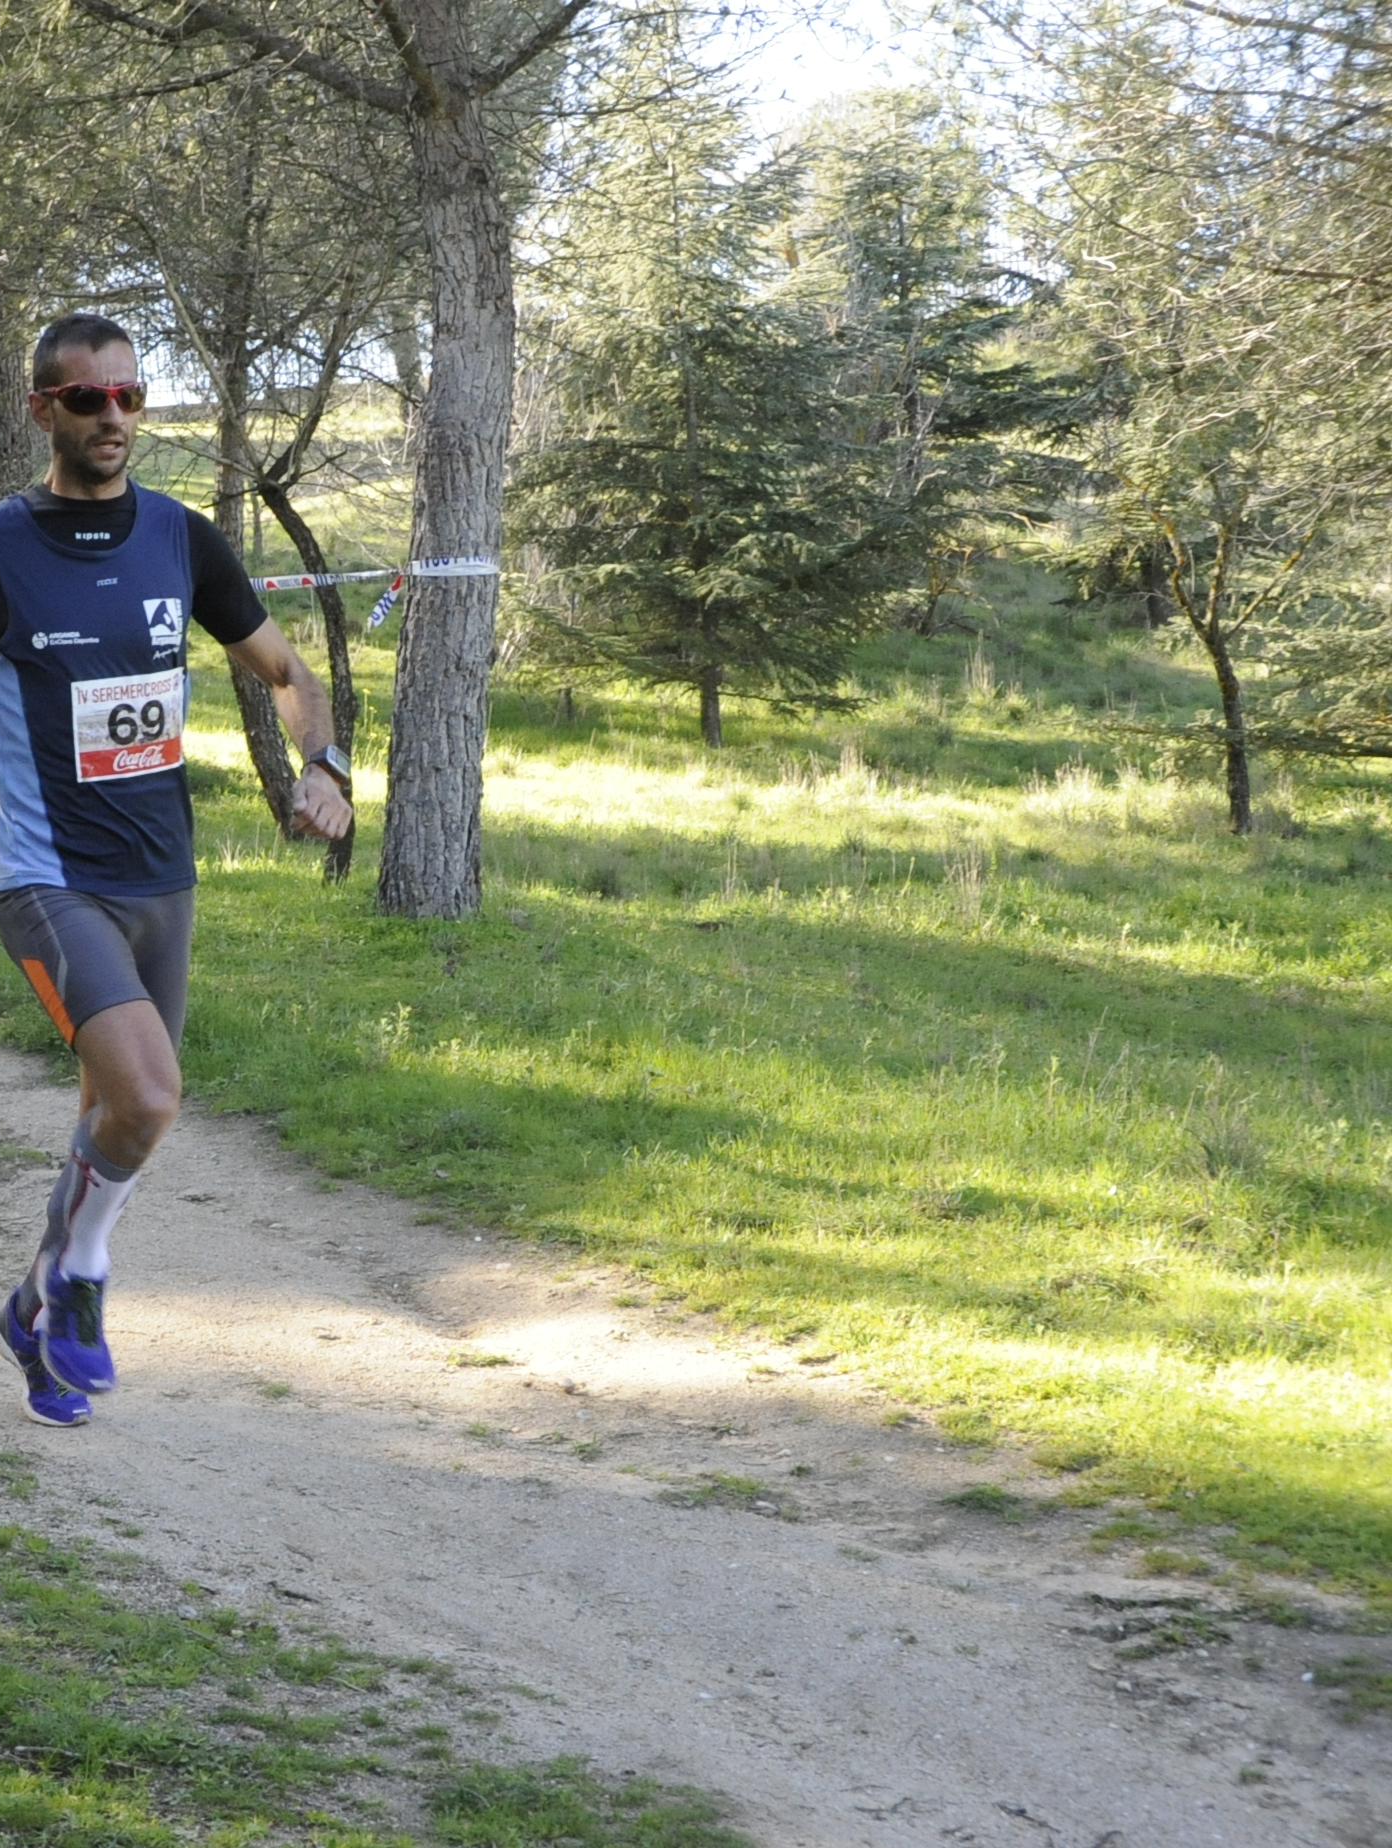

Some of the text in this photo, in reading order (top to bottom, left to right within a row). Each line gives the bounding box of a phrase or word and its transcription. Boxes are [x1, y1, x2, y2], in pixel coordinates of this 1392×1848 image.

[75, 531, 110, 541] kipsta
[77, 679, 172, 705] IV SEREMERCROSS
[108, 699, 165, 745] 69
